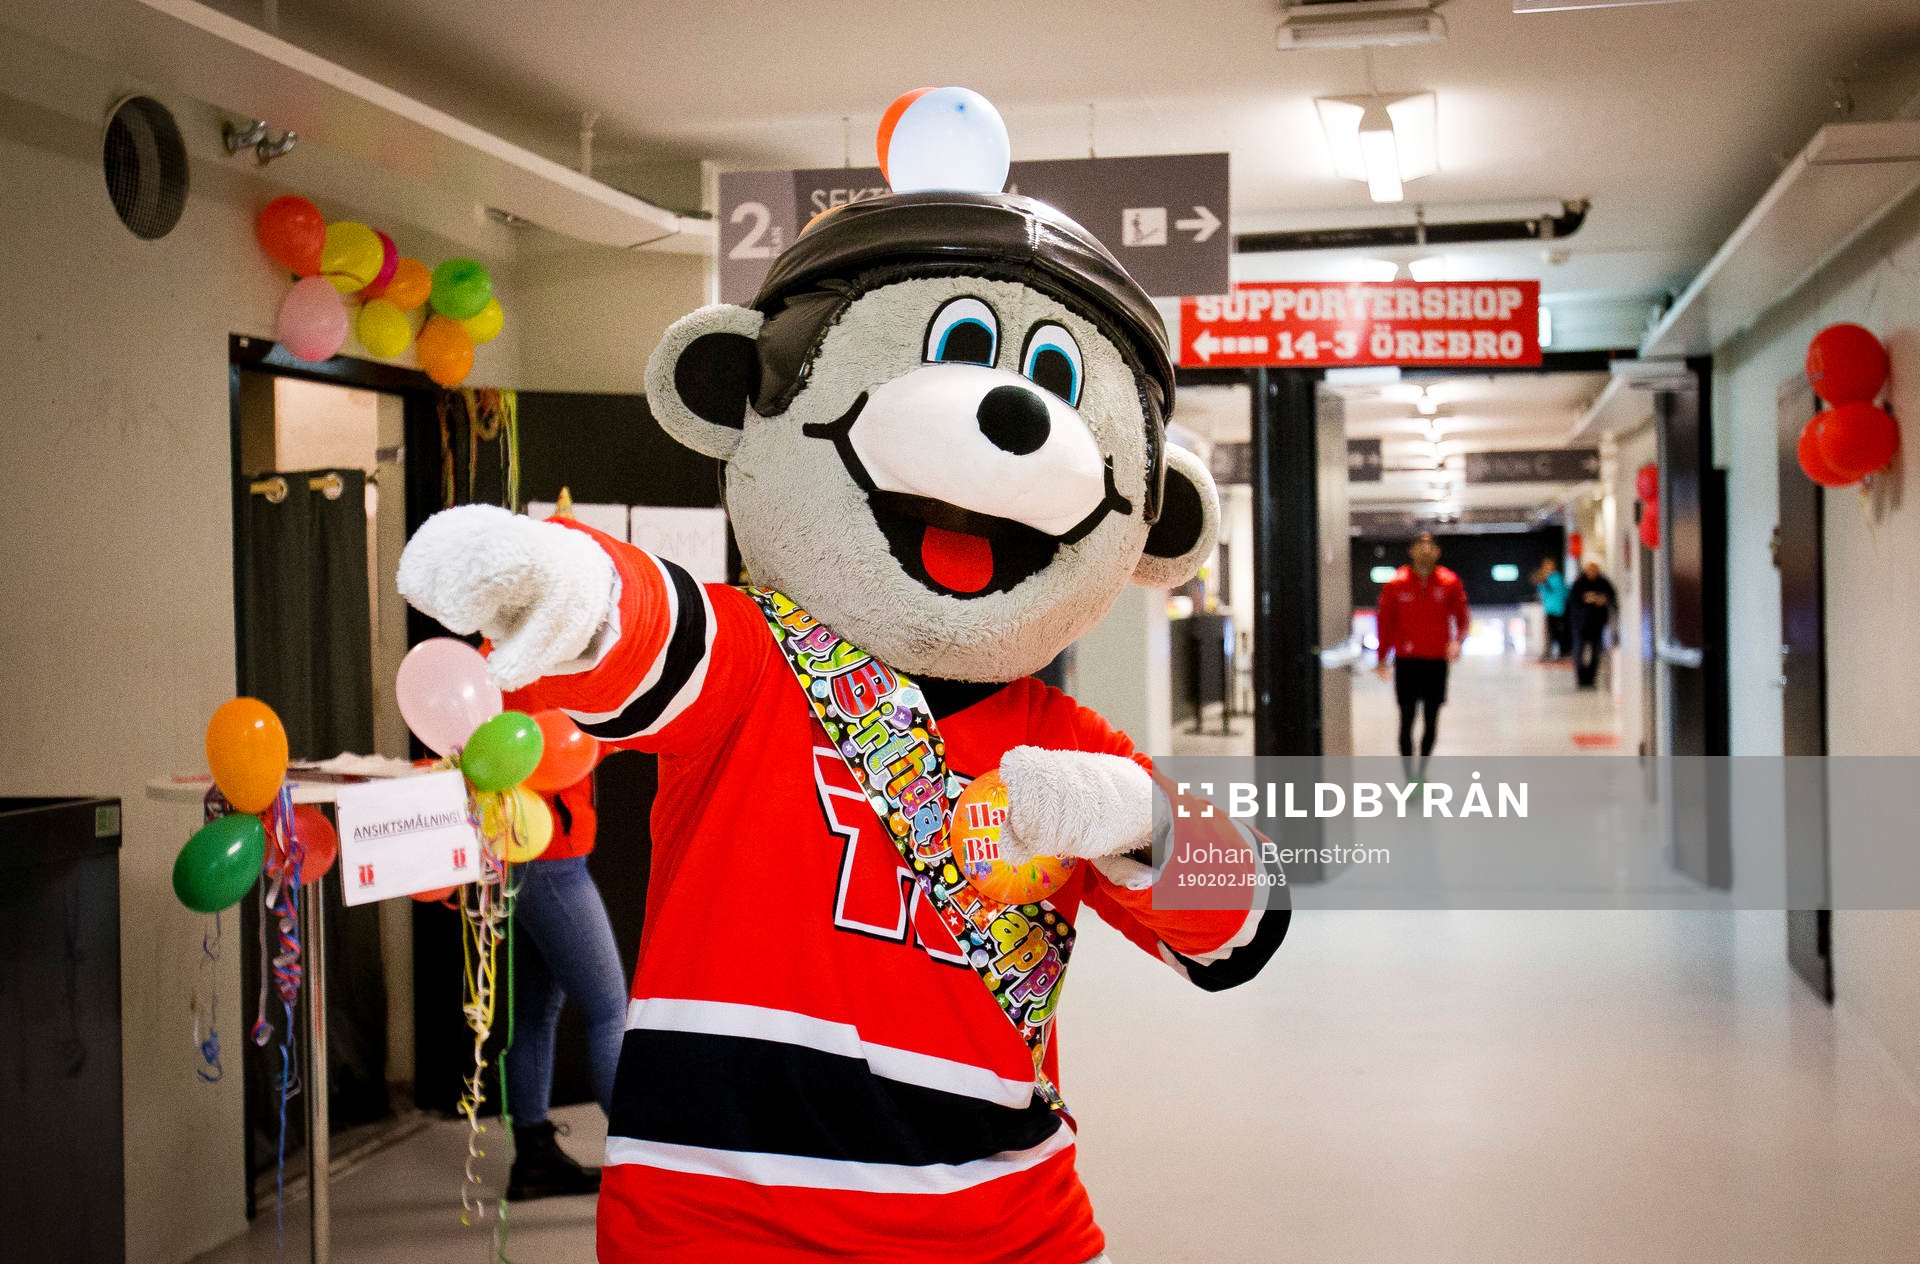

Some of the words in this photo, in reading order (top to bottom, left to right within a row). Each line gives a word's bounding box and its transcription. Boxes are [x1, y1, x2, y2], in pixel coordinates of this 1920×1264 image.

[728, 201, 771, 260] 2
[1195, 286, 1523, 322] SUPPORTERSHOP
[1276, 330, 1358, 361] 14-3
[1370, 323, 1523, 360] ÖREBRO
[353, 811, 461, 840] ANSIKTSMÅLNING!
